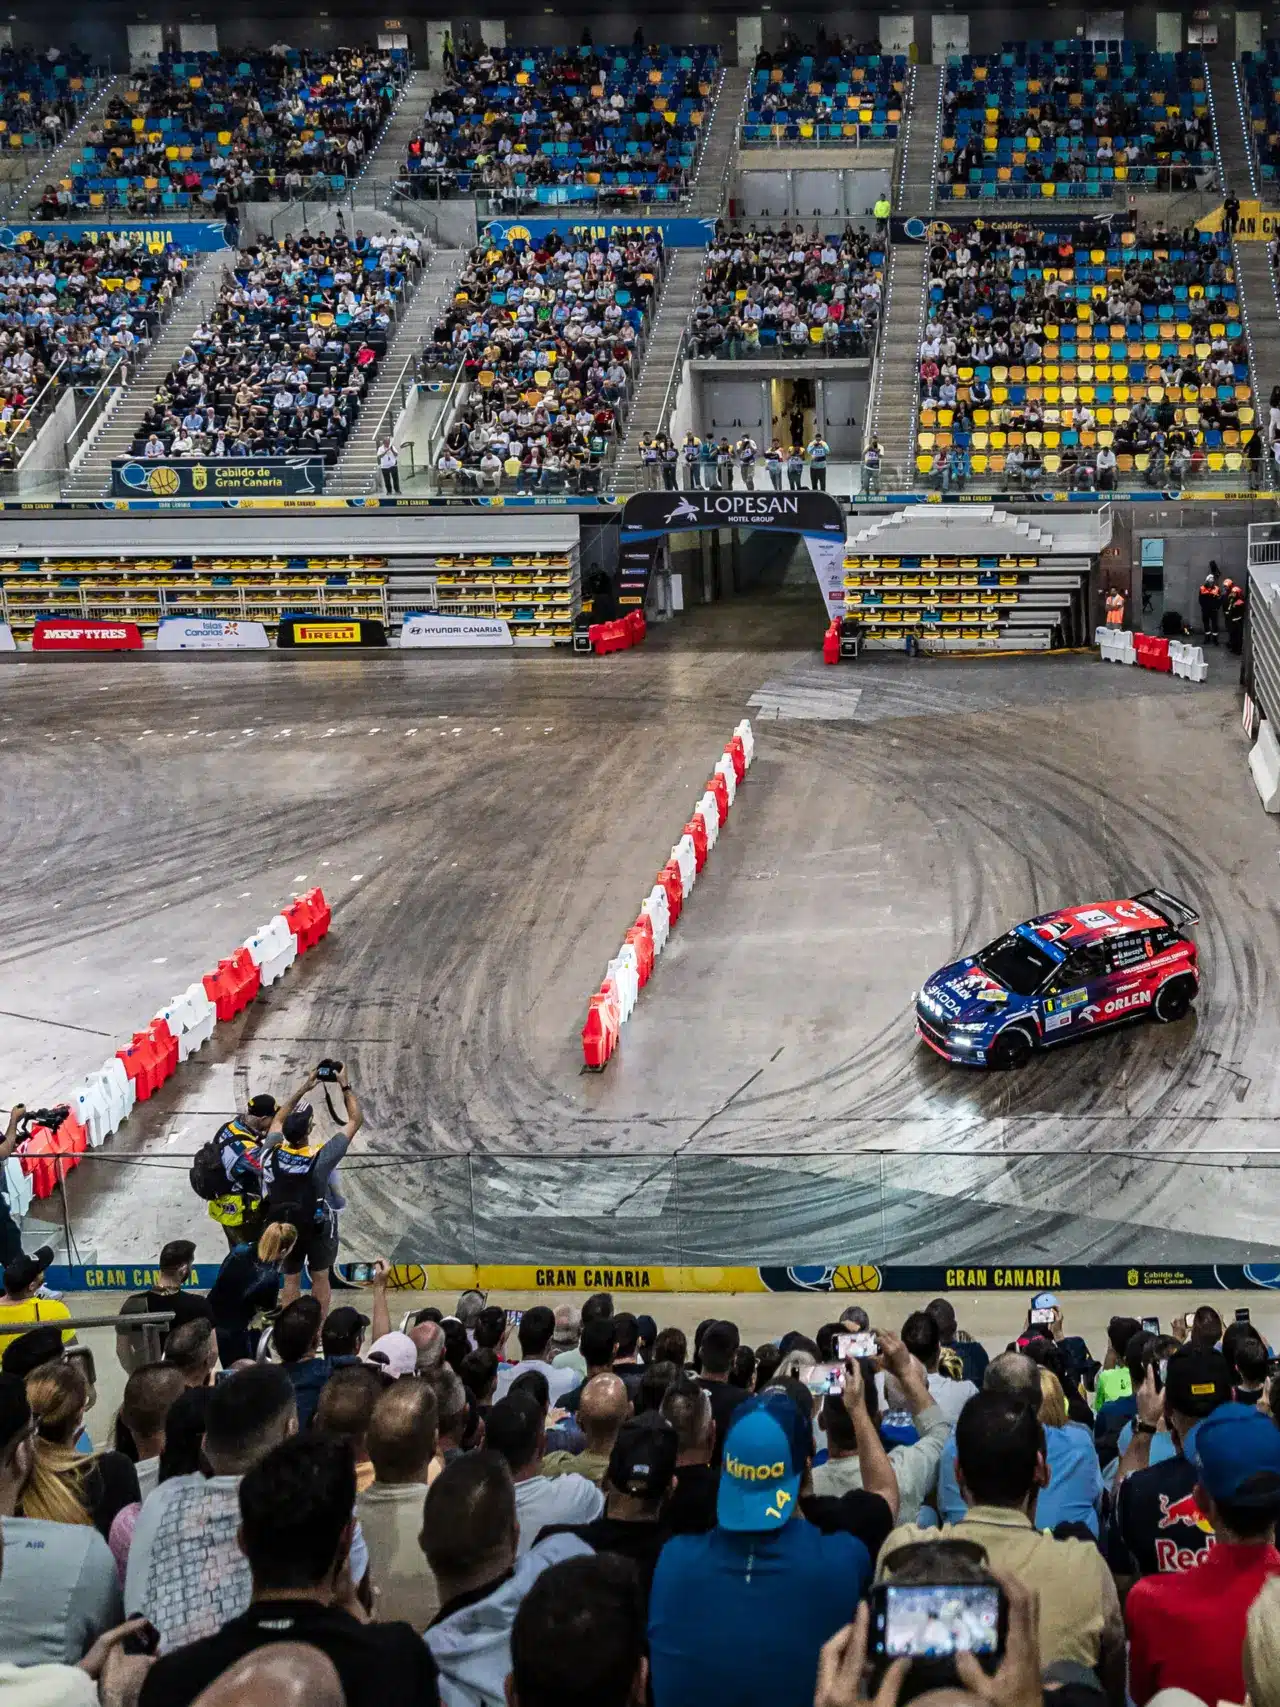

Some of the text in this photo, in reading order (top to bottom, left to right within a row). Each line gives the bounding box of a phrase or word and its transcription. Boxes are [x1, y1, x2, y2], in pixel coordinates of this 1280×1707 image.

[215, 467, 270, 478] Cabildo de
[215, 478, 282, 487] Gran Canaria
[704, 497, 798, 513] LOPESAN
[203, 622, 222, 630] Islas
[300, 627, 354, 640] PIRELLI
[424, 626, 502, 634] HYUNDAI CANARIAS
[43, 629, 127, 640] MRF TYRES
[1145, 941, 1154, 958] 6
[1104, 990, 1151, 1014] ORLEN
[86, 1269, 200, 1286] GRAN CANIA
[536, 1269, 650, 1288] GRAN CANARIA
[946, 1269, 1061, 1287] GRAN CANARIA
[726, 1452, 784, 1481] kimoa
[765, 1489, 791, 1518] 14
